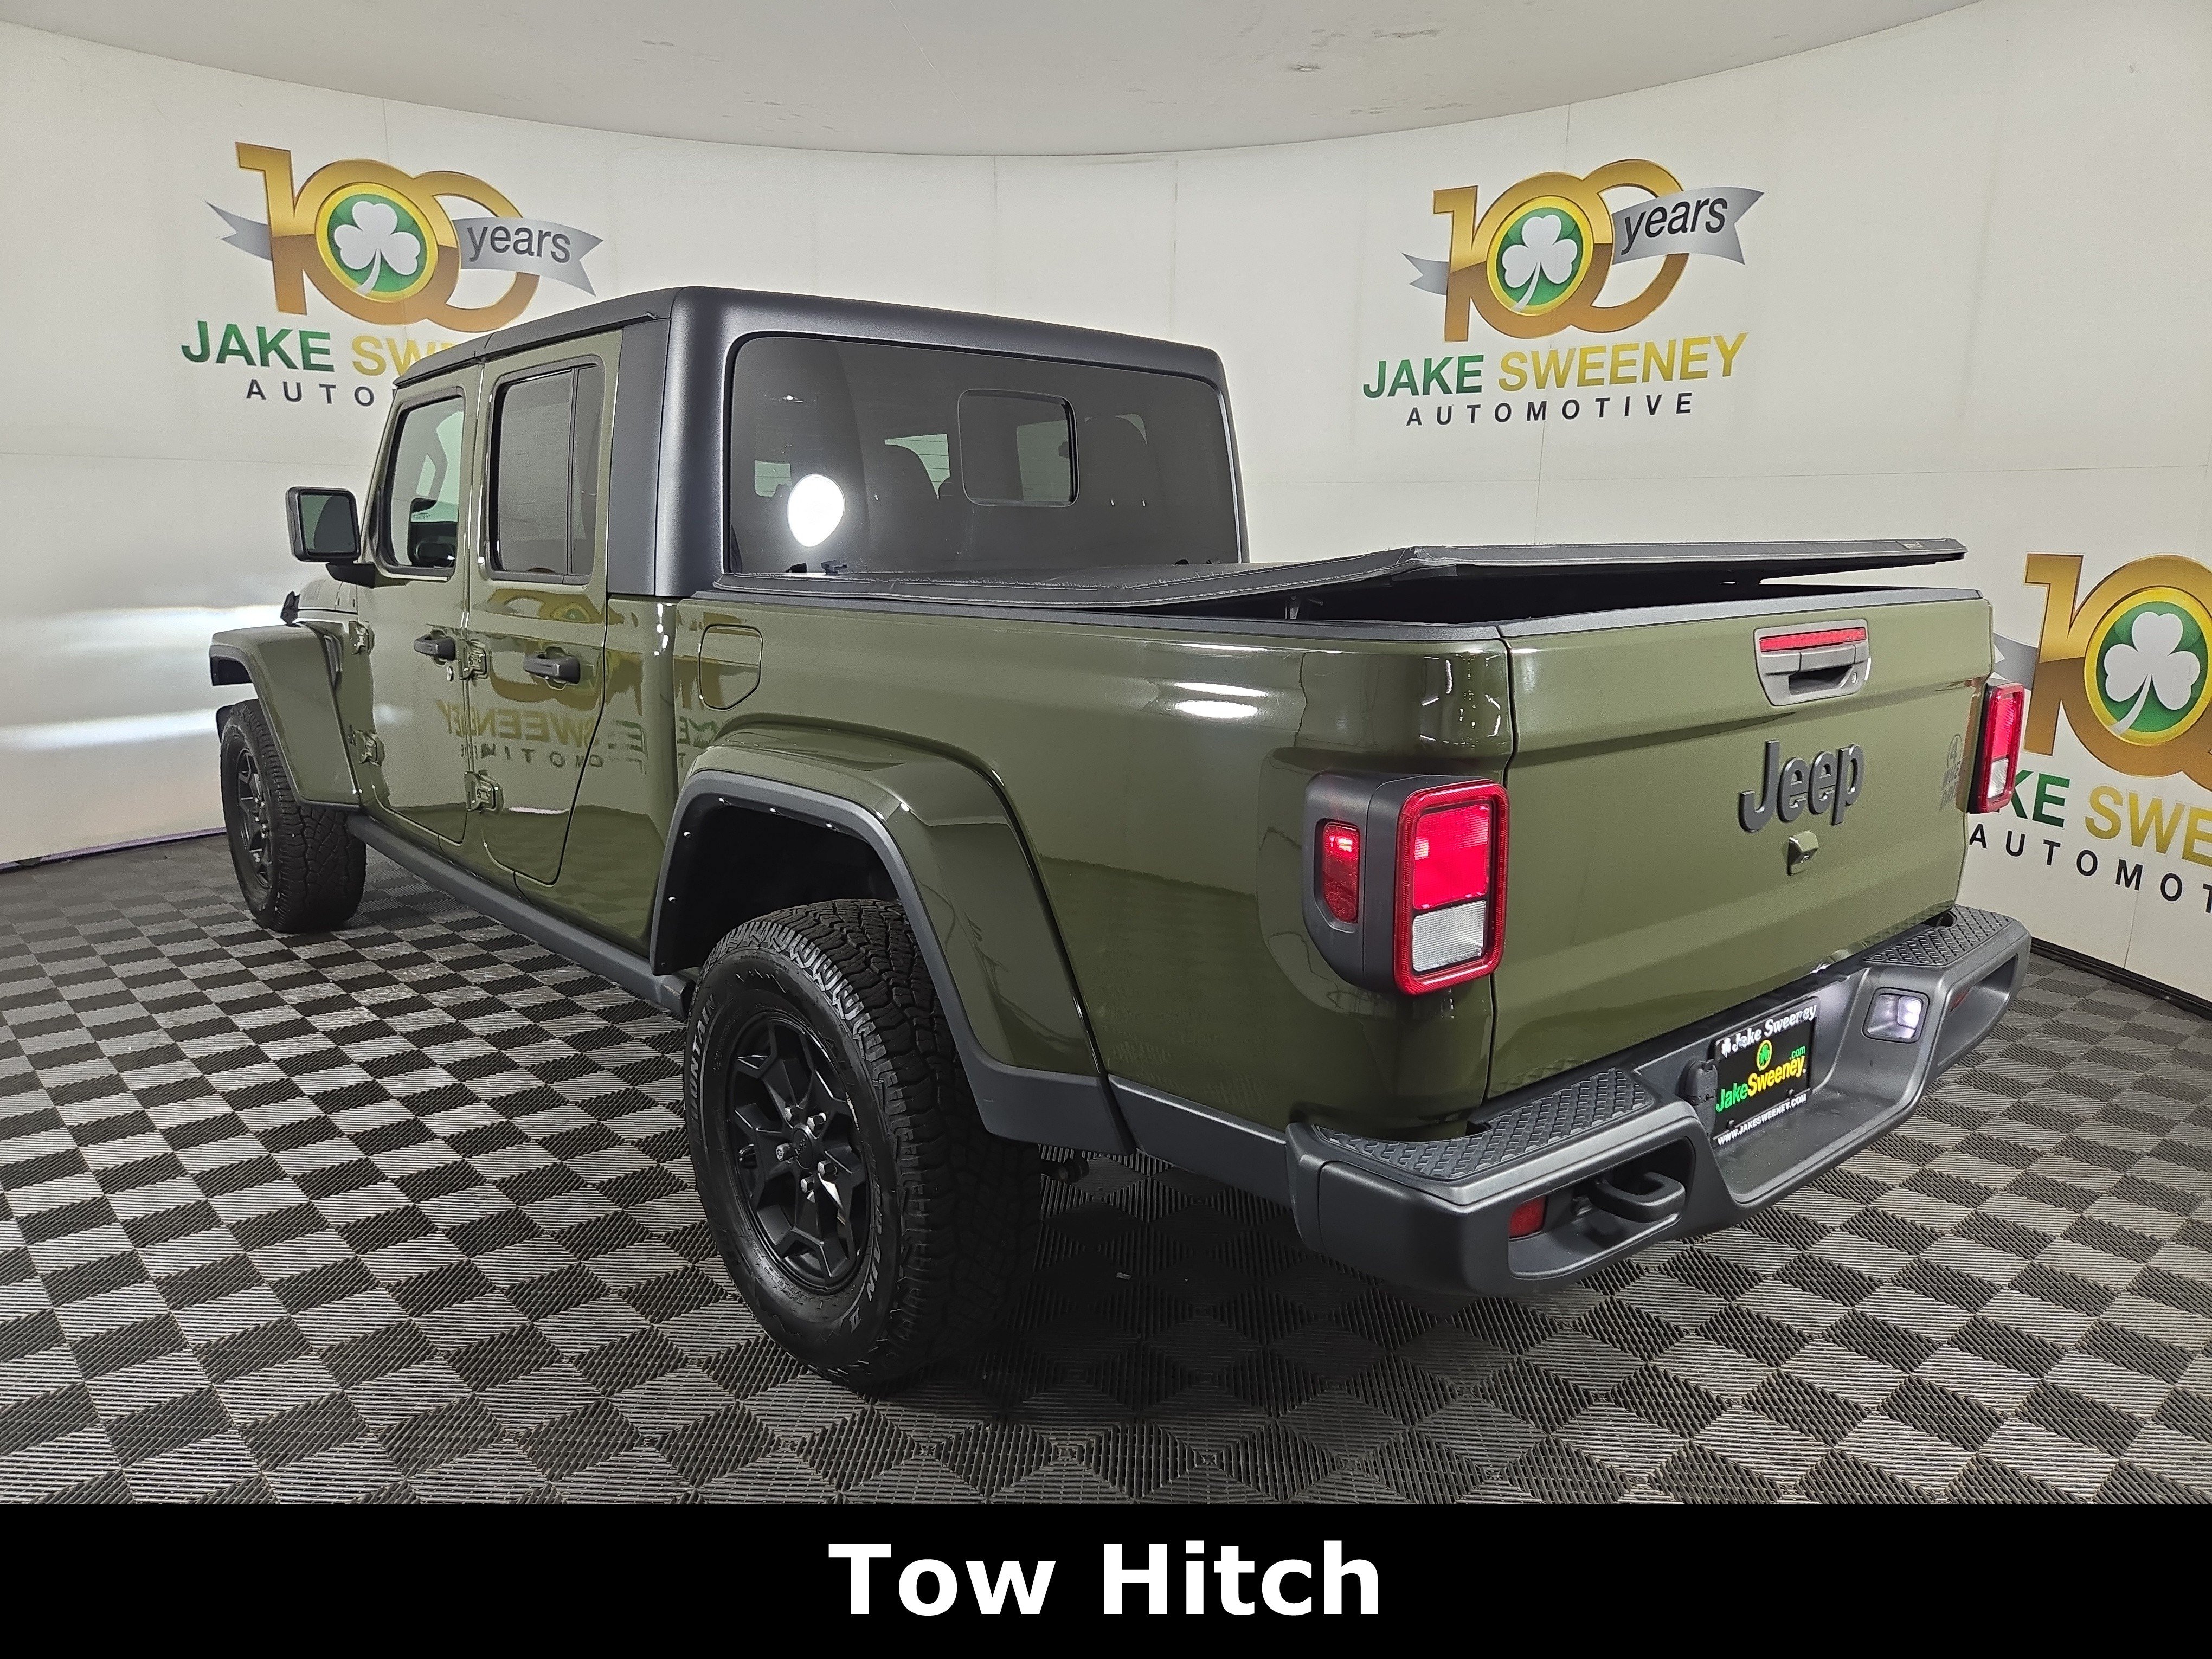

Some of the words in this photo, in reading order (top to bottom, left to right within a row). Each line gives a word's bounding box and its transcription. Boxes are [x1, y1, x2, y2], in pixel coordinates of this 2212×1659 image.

[235, 142, 540, 332] 100
[468, 224, 571, 263] years
[1433, 159, 1690, 342] 100
[1620, 197, 1728, 255] years
[181, 320, 335, 372] JAKE
[1362, 355, 1484, 398] JAKE
[1498, 332, 1748, 391] SWEENEY
[246, 378, 398, 406] AUTO
[1406, 393, 1693, 426] AUTOMOTIVE
[1739, 739, 1864, 833] Jeep
[1732, 1028, 1762, 1052] Jake
[1763, 1005, 1817, 1037] Sweeney
[1789, 1046, 1806, 1060] .com
